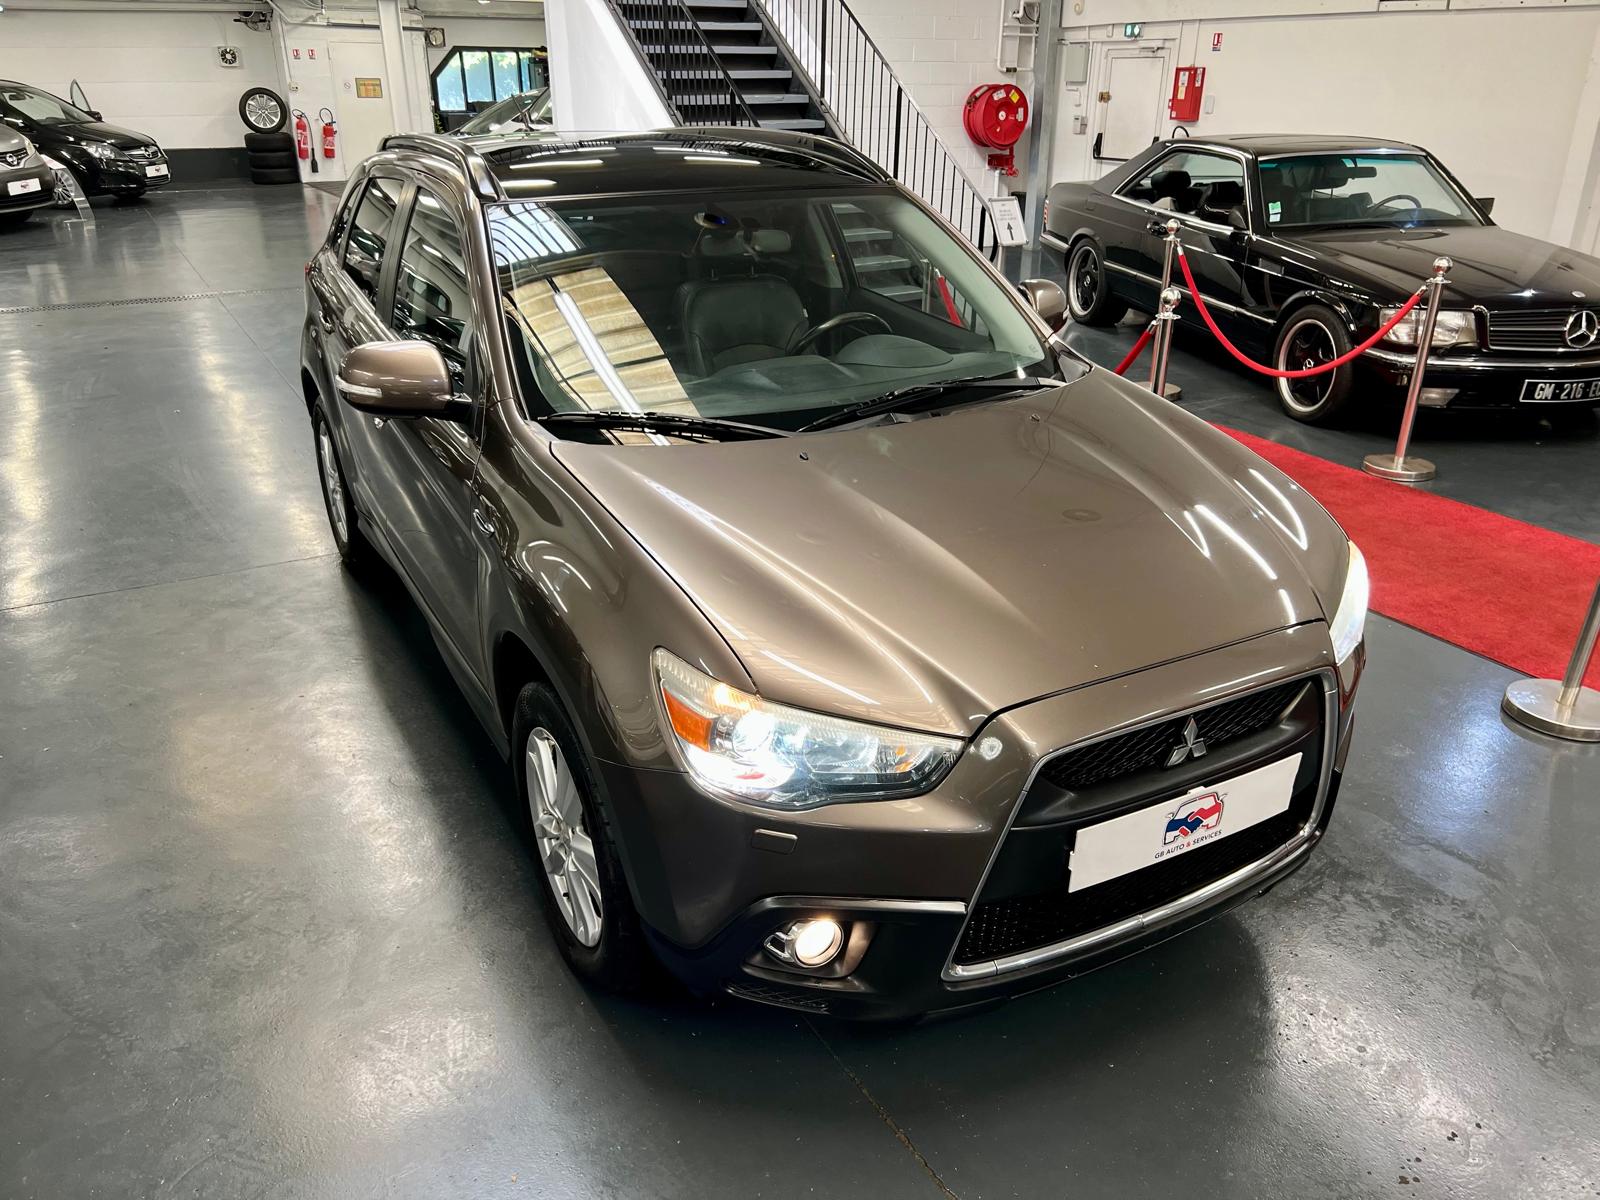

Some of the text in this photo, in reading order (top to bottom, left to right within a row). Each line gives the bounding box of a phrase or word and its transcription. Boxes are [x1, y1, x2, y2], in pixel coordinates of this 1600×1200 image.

[1154, 851, 1165, 859] GB
[1165, 843, 1185, 855] AUTO
[1192, 829, 1222, 846] SERVICES
